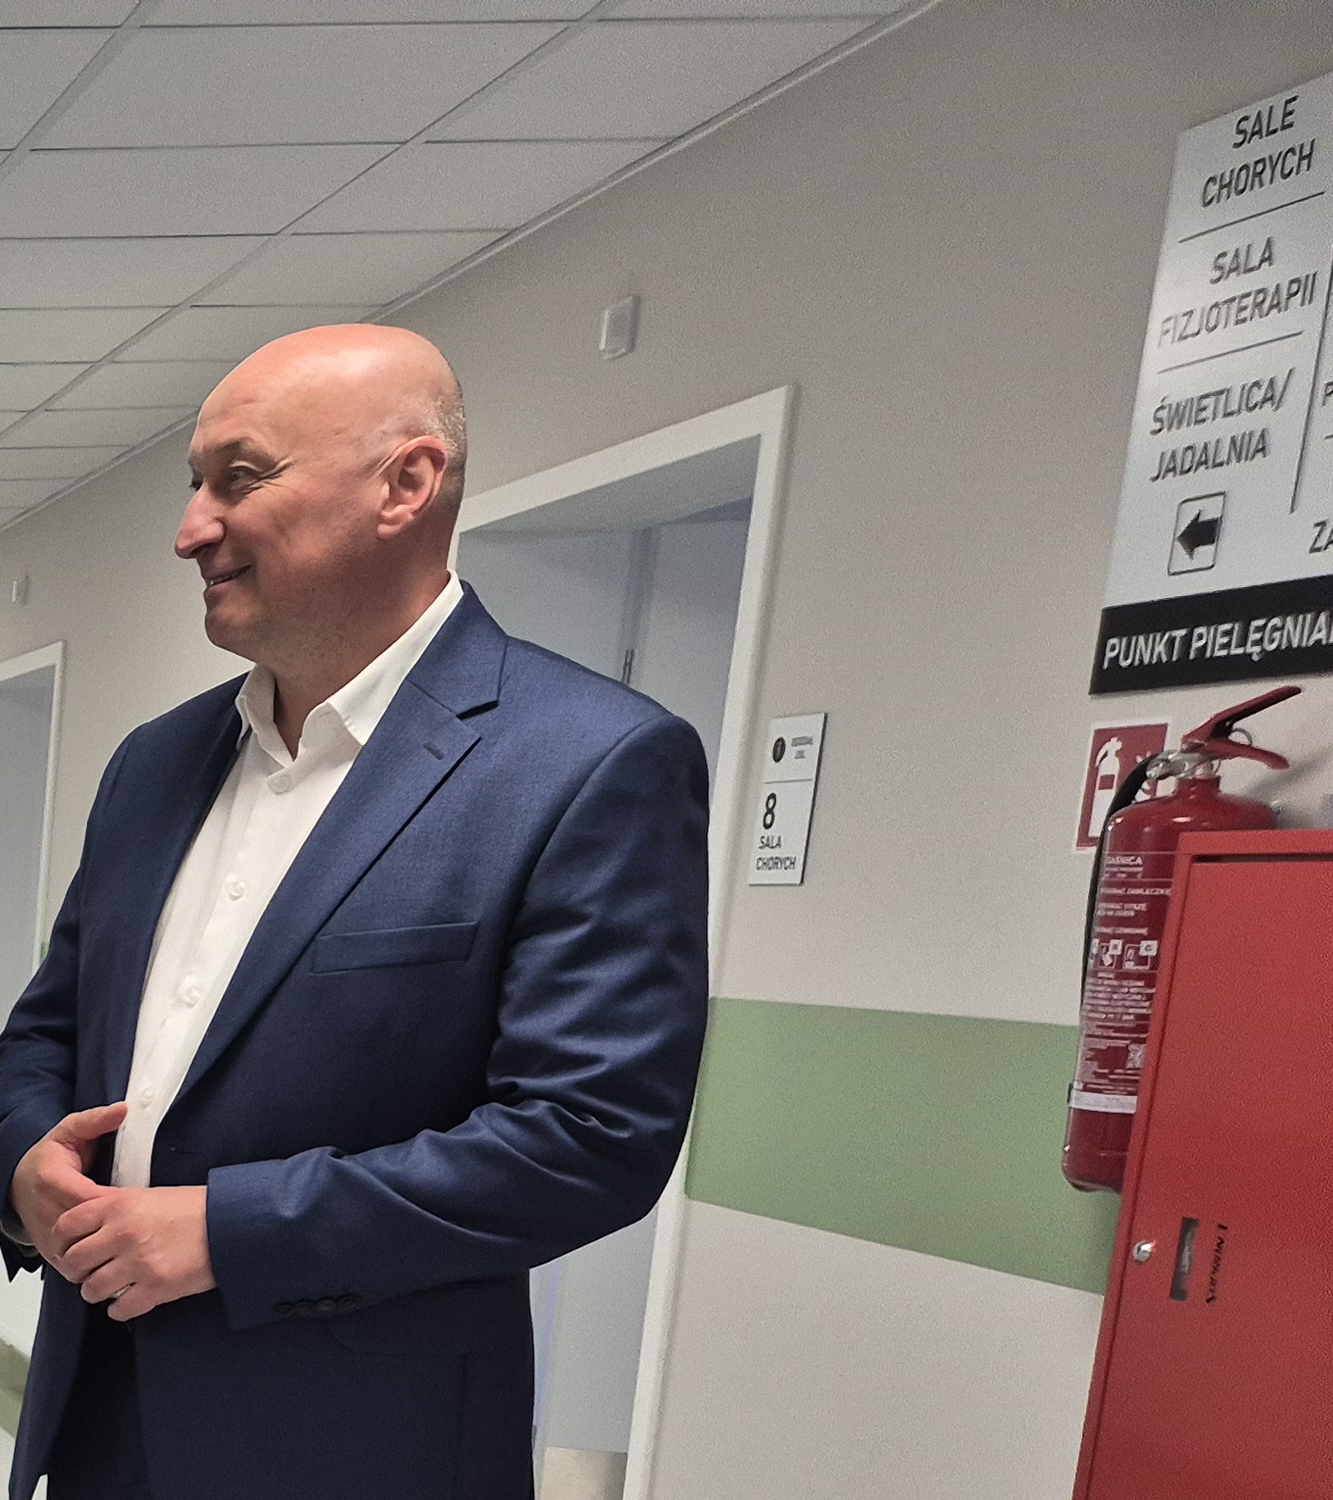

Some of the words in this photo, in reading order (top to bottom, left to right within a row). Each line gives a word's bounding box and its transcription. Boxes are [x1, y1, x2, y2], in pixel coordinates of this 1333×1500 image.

[1232, 94, 1299, 149] SALE
[1201, 138, 1316, 208] CHORYCH
[1210, 236, 1275, 285] SALA
[1157, 270, 1318, 348] FIZJOTERAPII
[1149, 367, 1295, 436] ŚWIETLICA/
[1149, 427, 1269, 483] JADALNIA
[1102, 628, 1188, 670] PUNKT
[1188, 610, 1333, 662] PIELĘGNIA
[762, 792, 777, 831] 8
[756, 856, 796, 871] CHORYCH
[758, 835, 782, 850] SALA
